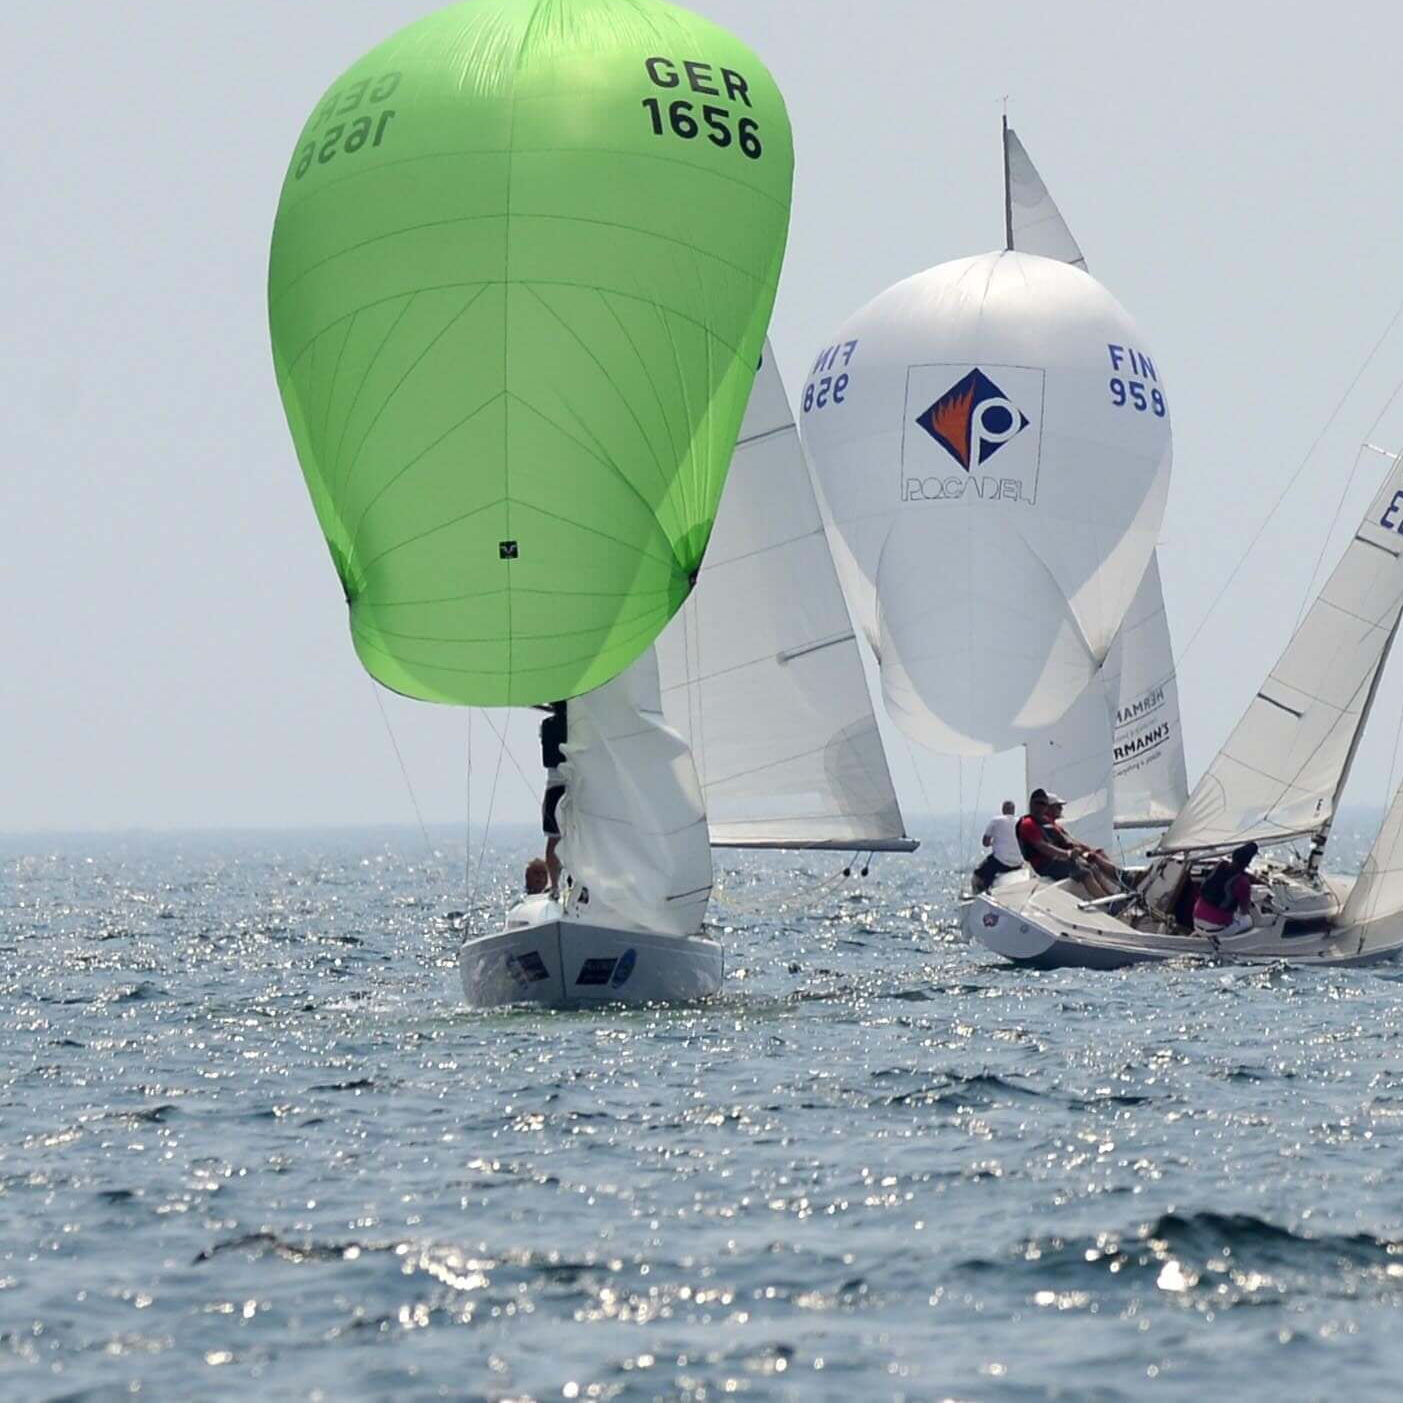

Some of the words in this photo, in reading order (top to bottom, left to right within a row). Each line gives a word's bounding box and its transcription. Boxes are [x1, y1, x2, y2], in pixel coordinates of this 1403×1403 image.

[645, 57, 752, 108] GER
[642, 98, 762, 159] 1656
[1108, 344, 1157, 382] FIN
[1110, 378, 1165, 417] 958
